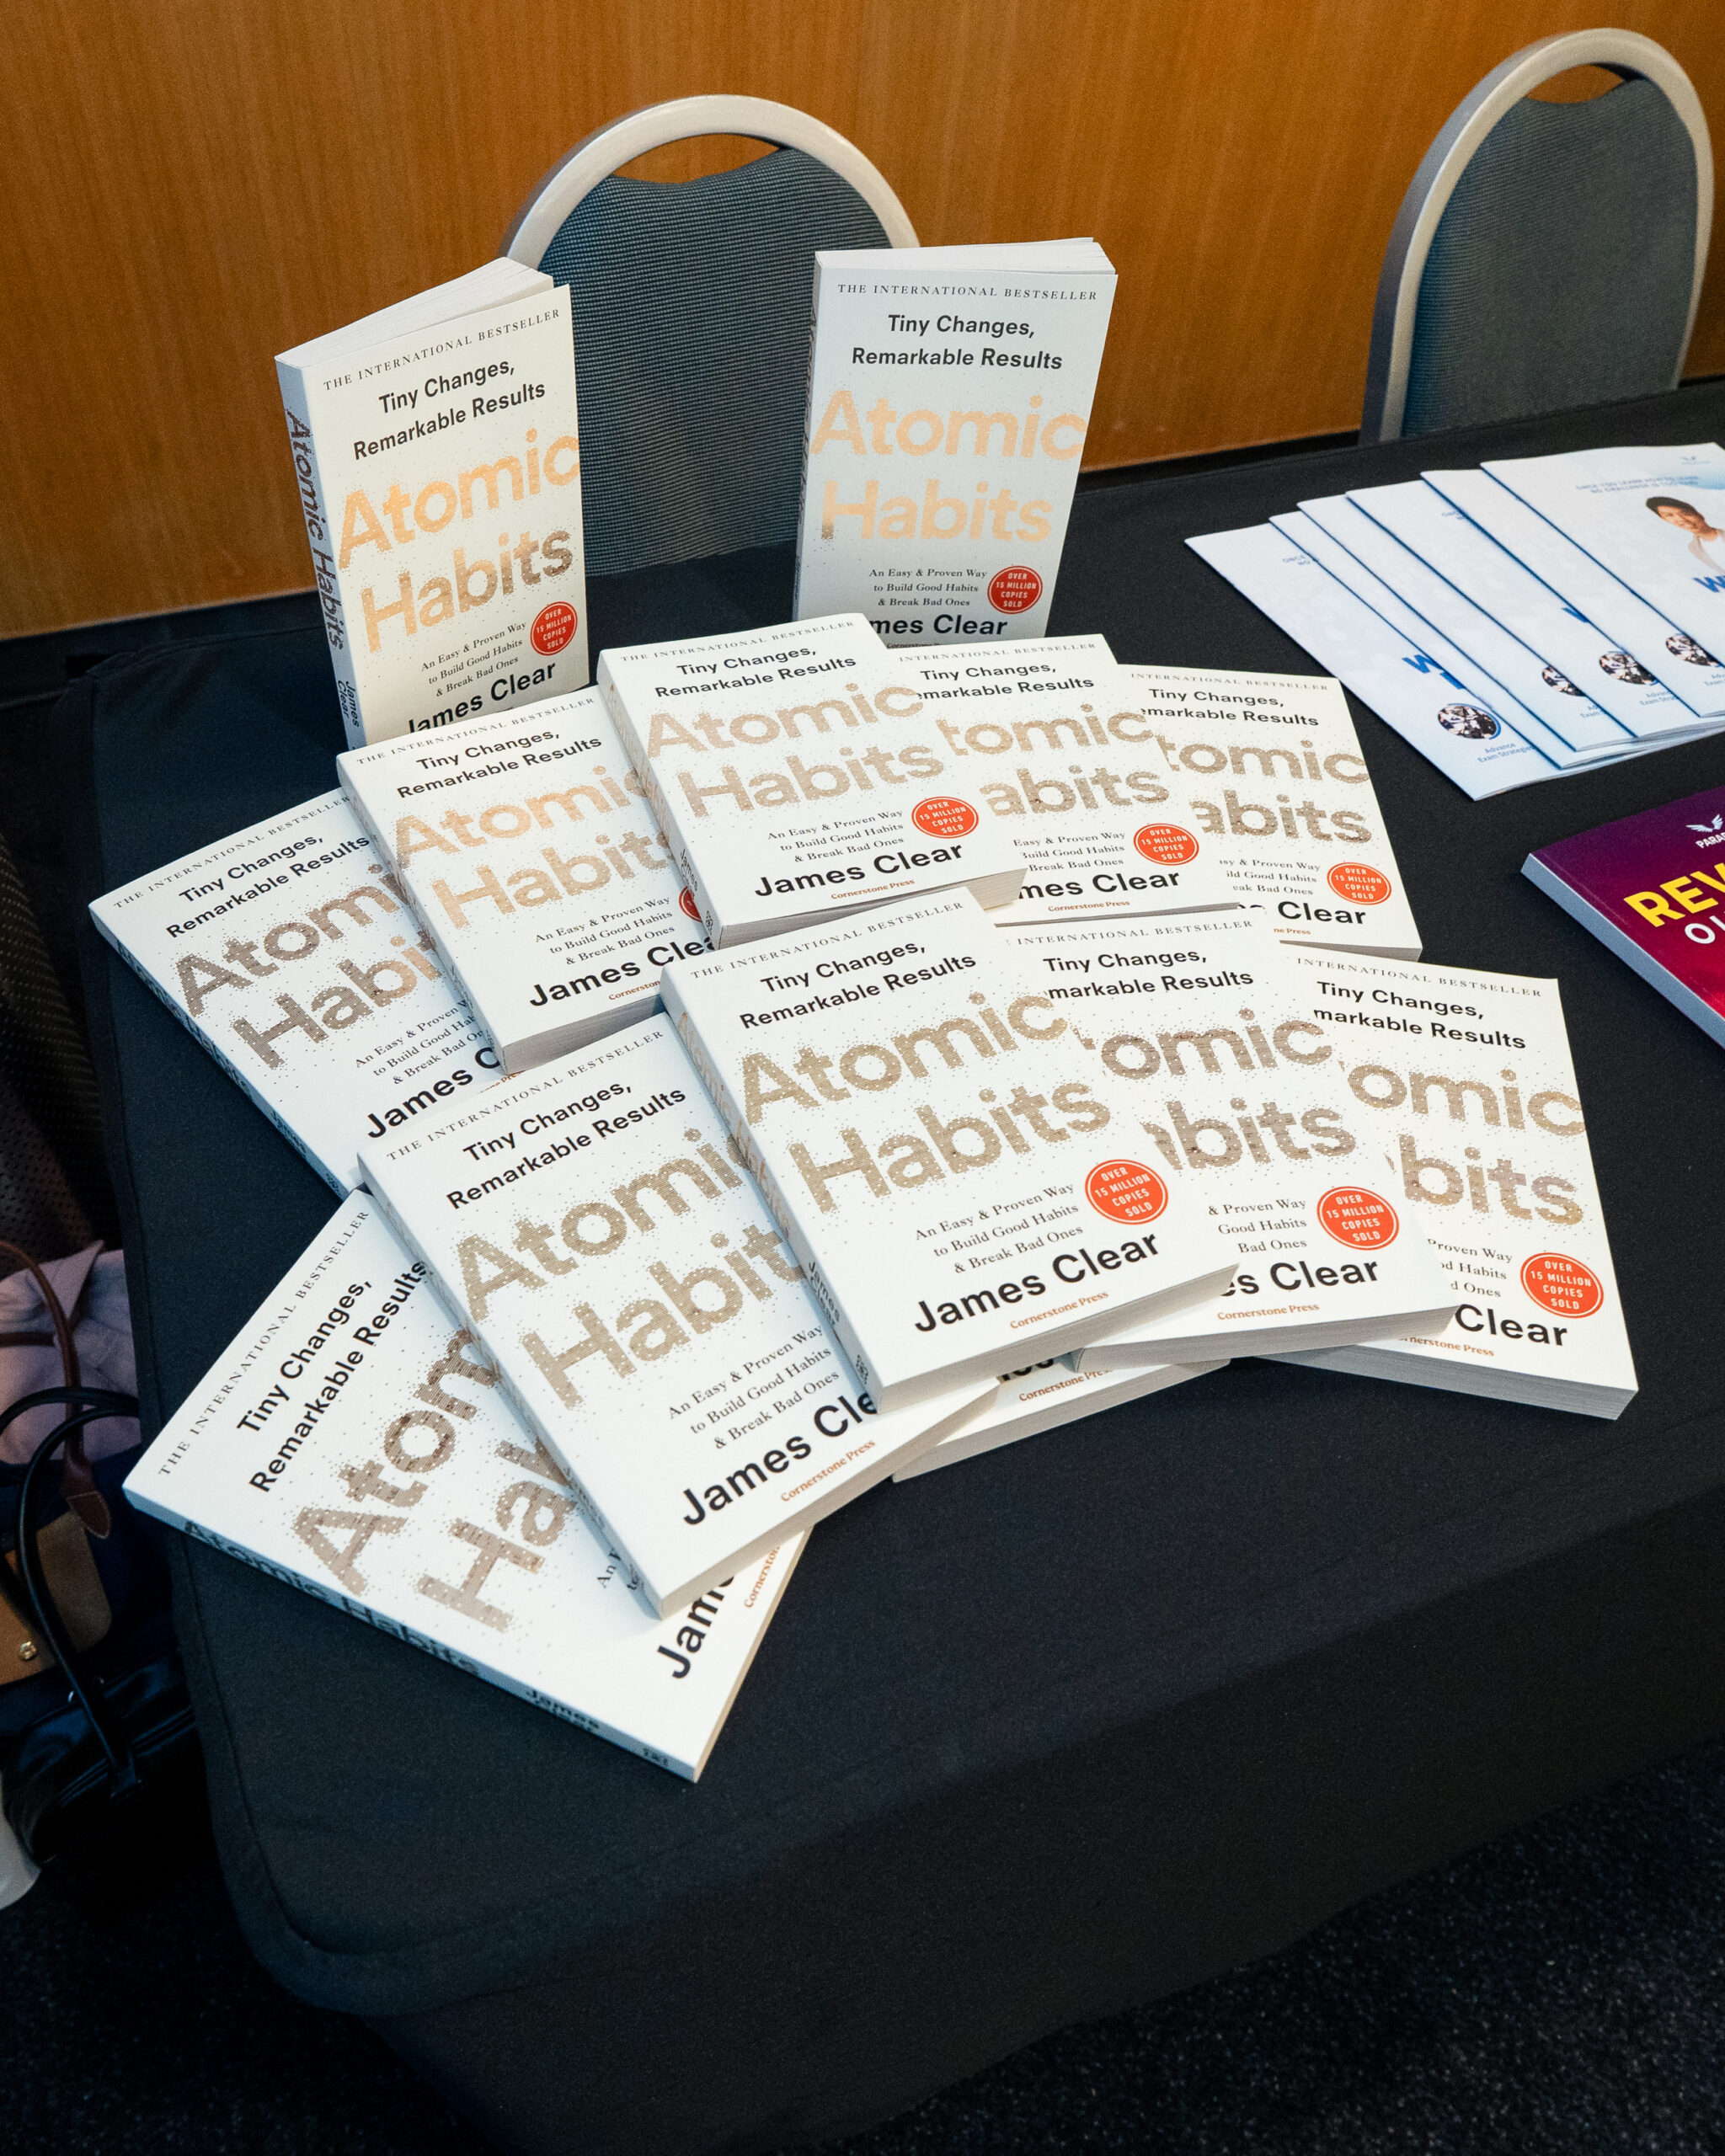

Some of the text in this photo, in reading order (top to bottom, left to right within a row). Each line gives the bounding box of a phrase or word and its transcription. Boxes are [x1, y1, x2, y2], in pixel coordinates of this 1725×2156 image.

[836, 282, 1096, 301] THE INTERNATIONAL BESTSELLER
[323, 309, 559, 391] THE INTERNATIONAL BESTSELLER
[887, 312, 1035, 339] Tiny Changes,
[852, 344, 1063, 369] Remarkable Results
[377, 358, 514, 413] Tiny Changes,
[352, 381, 545, 458] Remarkable Results
[809, 387, 1087, 460] Atomic
[334, 427, 579, 568] Atomic
[821, 477, 1054, 542] Habits
[287, 409, 343, 649] Atomic Habits
[359, 528, 573, 648] Habits
[868, 568, 987, 579] An Easy & Proven Way
[619, 622, 854, 662] THE INTERNATIONAL BESTSELLER
[932, 614, 1007, 635] Clear
[490, 661, 555, 702] Clear
[654, 659, 857, 699] Remarkable Results
[675, 648, 816, 675] Tiny Changes,
[918, 676, 1094, 700] markable Results
[919, 663, 1056, 681] Tiny Changes,
[338, 680, 349, 719] Clear
[345, 680, 360, 728] James
[645, 683, 924, 761] Atomic
[1141, 707, 1320, 726] markable Results
[1147, 686, 1284, 707] Tiny Changes,
[414, 730, 560, 770] Tiny Changes,
[935, 703, 1154, 756] tomic
[395, 739, 602, 797] Remarkable Results
[676, 745, 944, 819] Habits
[1154, 735, 1370, 784] tomic
[980, 765, 1170, 816] abits
[1189, 789, 1373, 843] abits
[163, 835, 369, 937] Remarkable Results
[177, 834, 323, 902] Tiny Changes,
[754, 844, 962, 898] James Clear
[830, 879, 915, 900] Cornerstone Press
[1091, 872, 1180, 893] Clear
[1017, 921, 1252, 944] INTERNATIONAL BESTSELLER
[1275, 899, 1367, 924] Clear
[175, 863, 411, 1018] Atomi
[689, 901, 963, 979] THE INTERNATIONAL BESTSELLER
[1041, 950, 1206, 974] Tiny Changes,
[529, 962, 641, 1007] James
[738, 955, 976, 1029] Remarkable Results
[759, 942, 925, 992] Tiny Changes,
[1047, 970, 1254, 999] markable Results
[1298, 955, 1540, 999] INTERNATIONAL BESTSELLER
[1316, 979, 1483, 1021] Tiny Changes,
[1073, 1007, 1332, 1080] omic
[1314, 1009, 1525, 1049] markable Results
[740, 991, 1069, 1126] Atomic
[366, 1068, 473, 1139] James
[385, 1139, 422, 1160] THE
[426, 1075, 563, 1140] INTERNATIONAL
[567, 1031, 663, 1079] BESTSELLER
[461, 1130, 515, 1161] Tiny
[519, 1081, 631, 1135] Changes,
[1348, 1064, 1587, 1137] omic
[444, 1088, 686, 1208] Remarkable Results
[788, 1082, 1111, 1213] Habits
[1141, 1097, 1356, 1171] bits
[1093, 1172, 1151, 1198] 15 MILLION
[1100, 1166, 1129, 1182] OVER
[1111, 1187, 1150, 1207] COPIES
[1399, 1134, 1584, 1225] bits
[916, 1183, 1073, 1241] An Easy & Proven Way
[932, 1204, 1079, 1257] to Build Good Habits
[1124, 1201, 1153, 1217] SOLD
[953, 1226, 1083, 1274] & Break Bad Ones
[1268, 1260, 1378, 1291] Clear
[914, 1233, 1158, 1332] James Clear
[521, 1224, 806, 1410] Habit
[1009, 1291, 1109, 1329] Cornerstone Press
[1452, 1303, 1567, 1347] Clear
[157, 1211, 368, 1475] THE INTERNATIONAL BESTSELLER
[235, 1278, 371, 1431] Tiny Changes,
[247, 1259, 427, 1492] Remarkable Results
[1018, 1375, 1085, 1401] Cornerstone
[291, 1328, 502, 1597] Atom
[681, 1434, 811, 1526] James
[780, 1439, 875, 1502] Cornerstone Press
